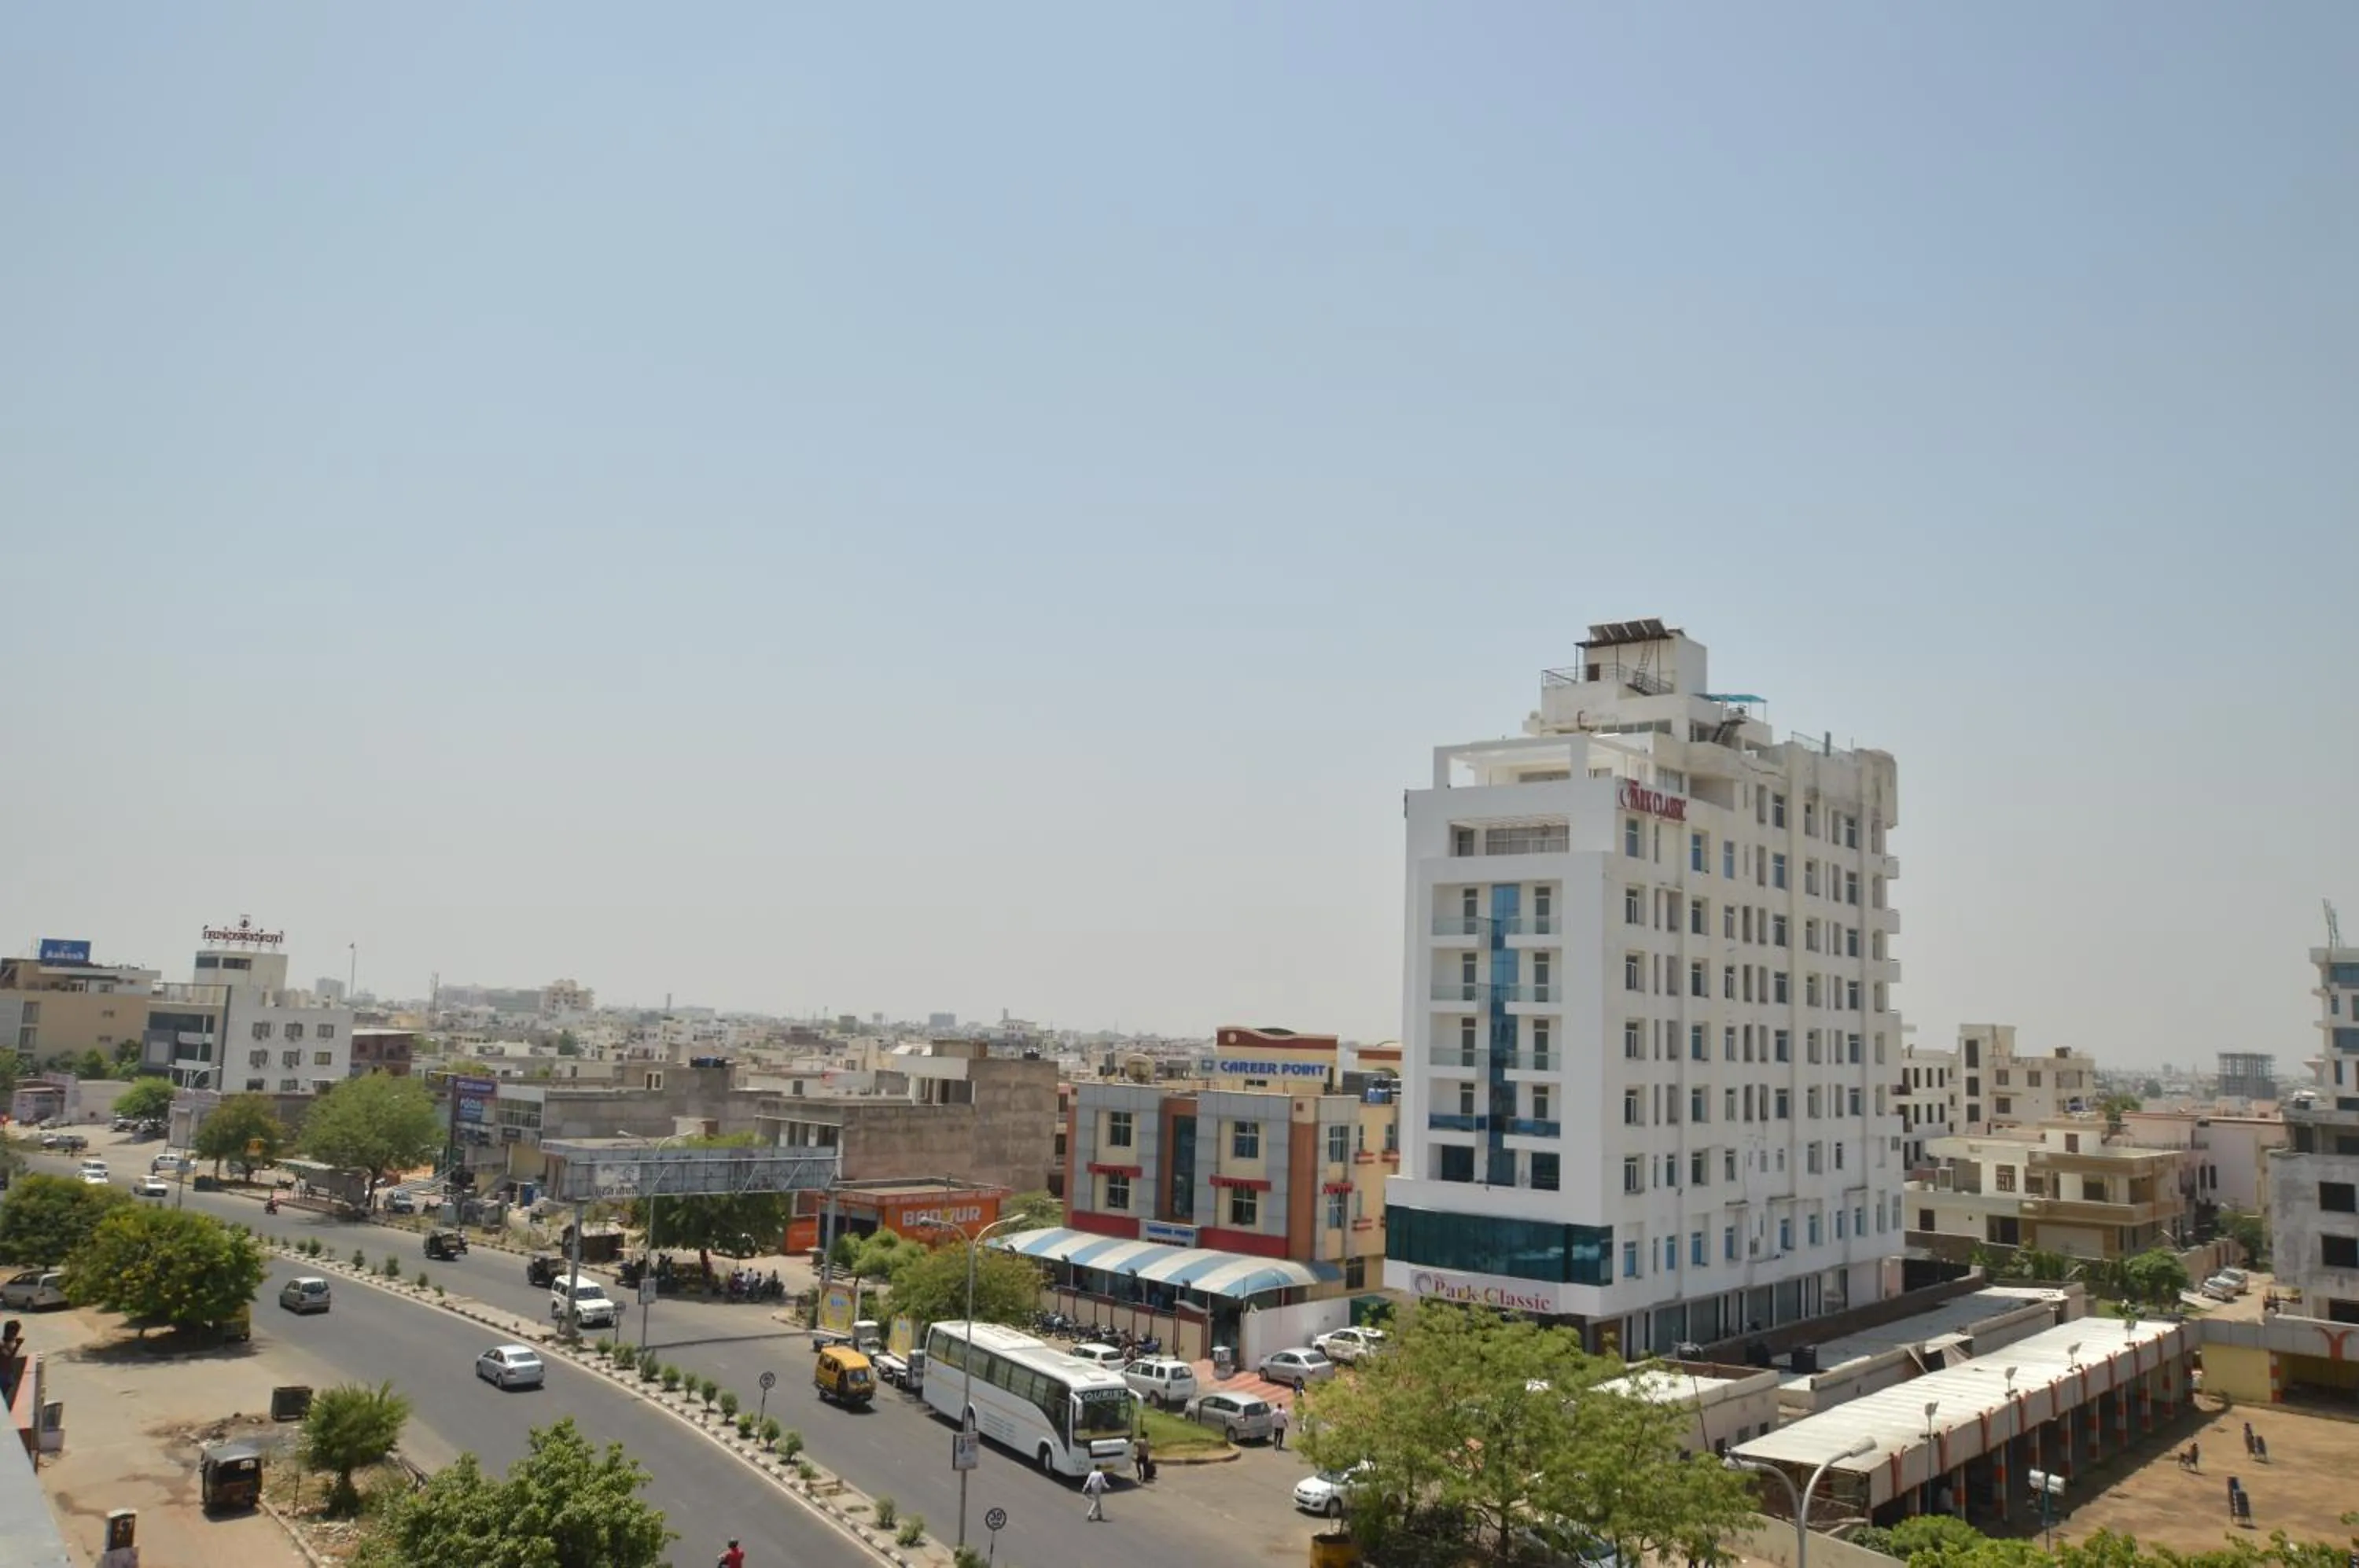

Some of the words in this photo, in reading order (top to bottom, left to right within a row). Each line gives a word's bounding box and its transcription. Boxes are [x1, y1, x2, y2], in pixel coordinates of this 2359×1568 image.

[1220, 1061, 1278, 1075] CAREER
[1281, 1063, 1326, 1077] POINT
[1434, 1279, 1478, 1301] Park
[1483, 1286, 1551, 1312] Classic
[1078, 1389, 1127, 1402] TOURIST
